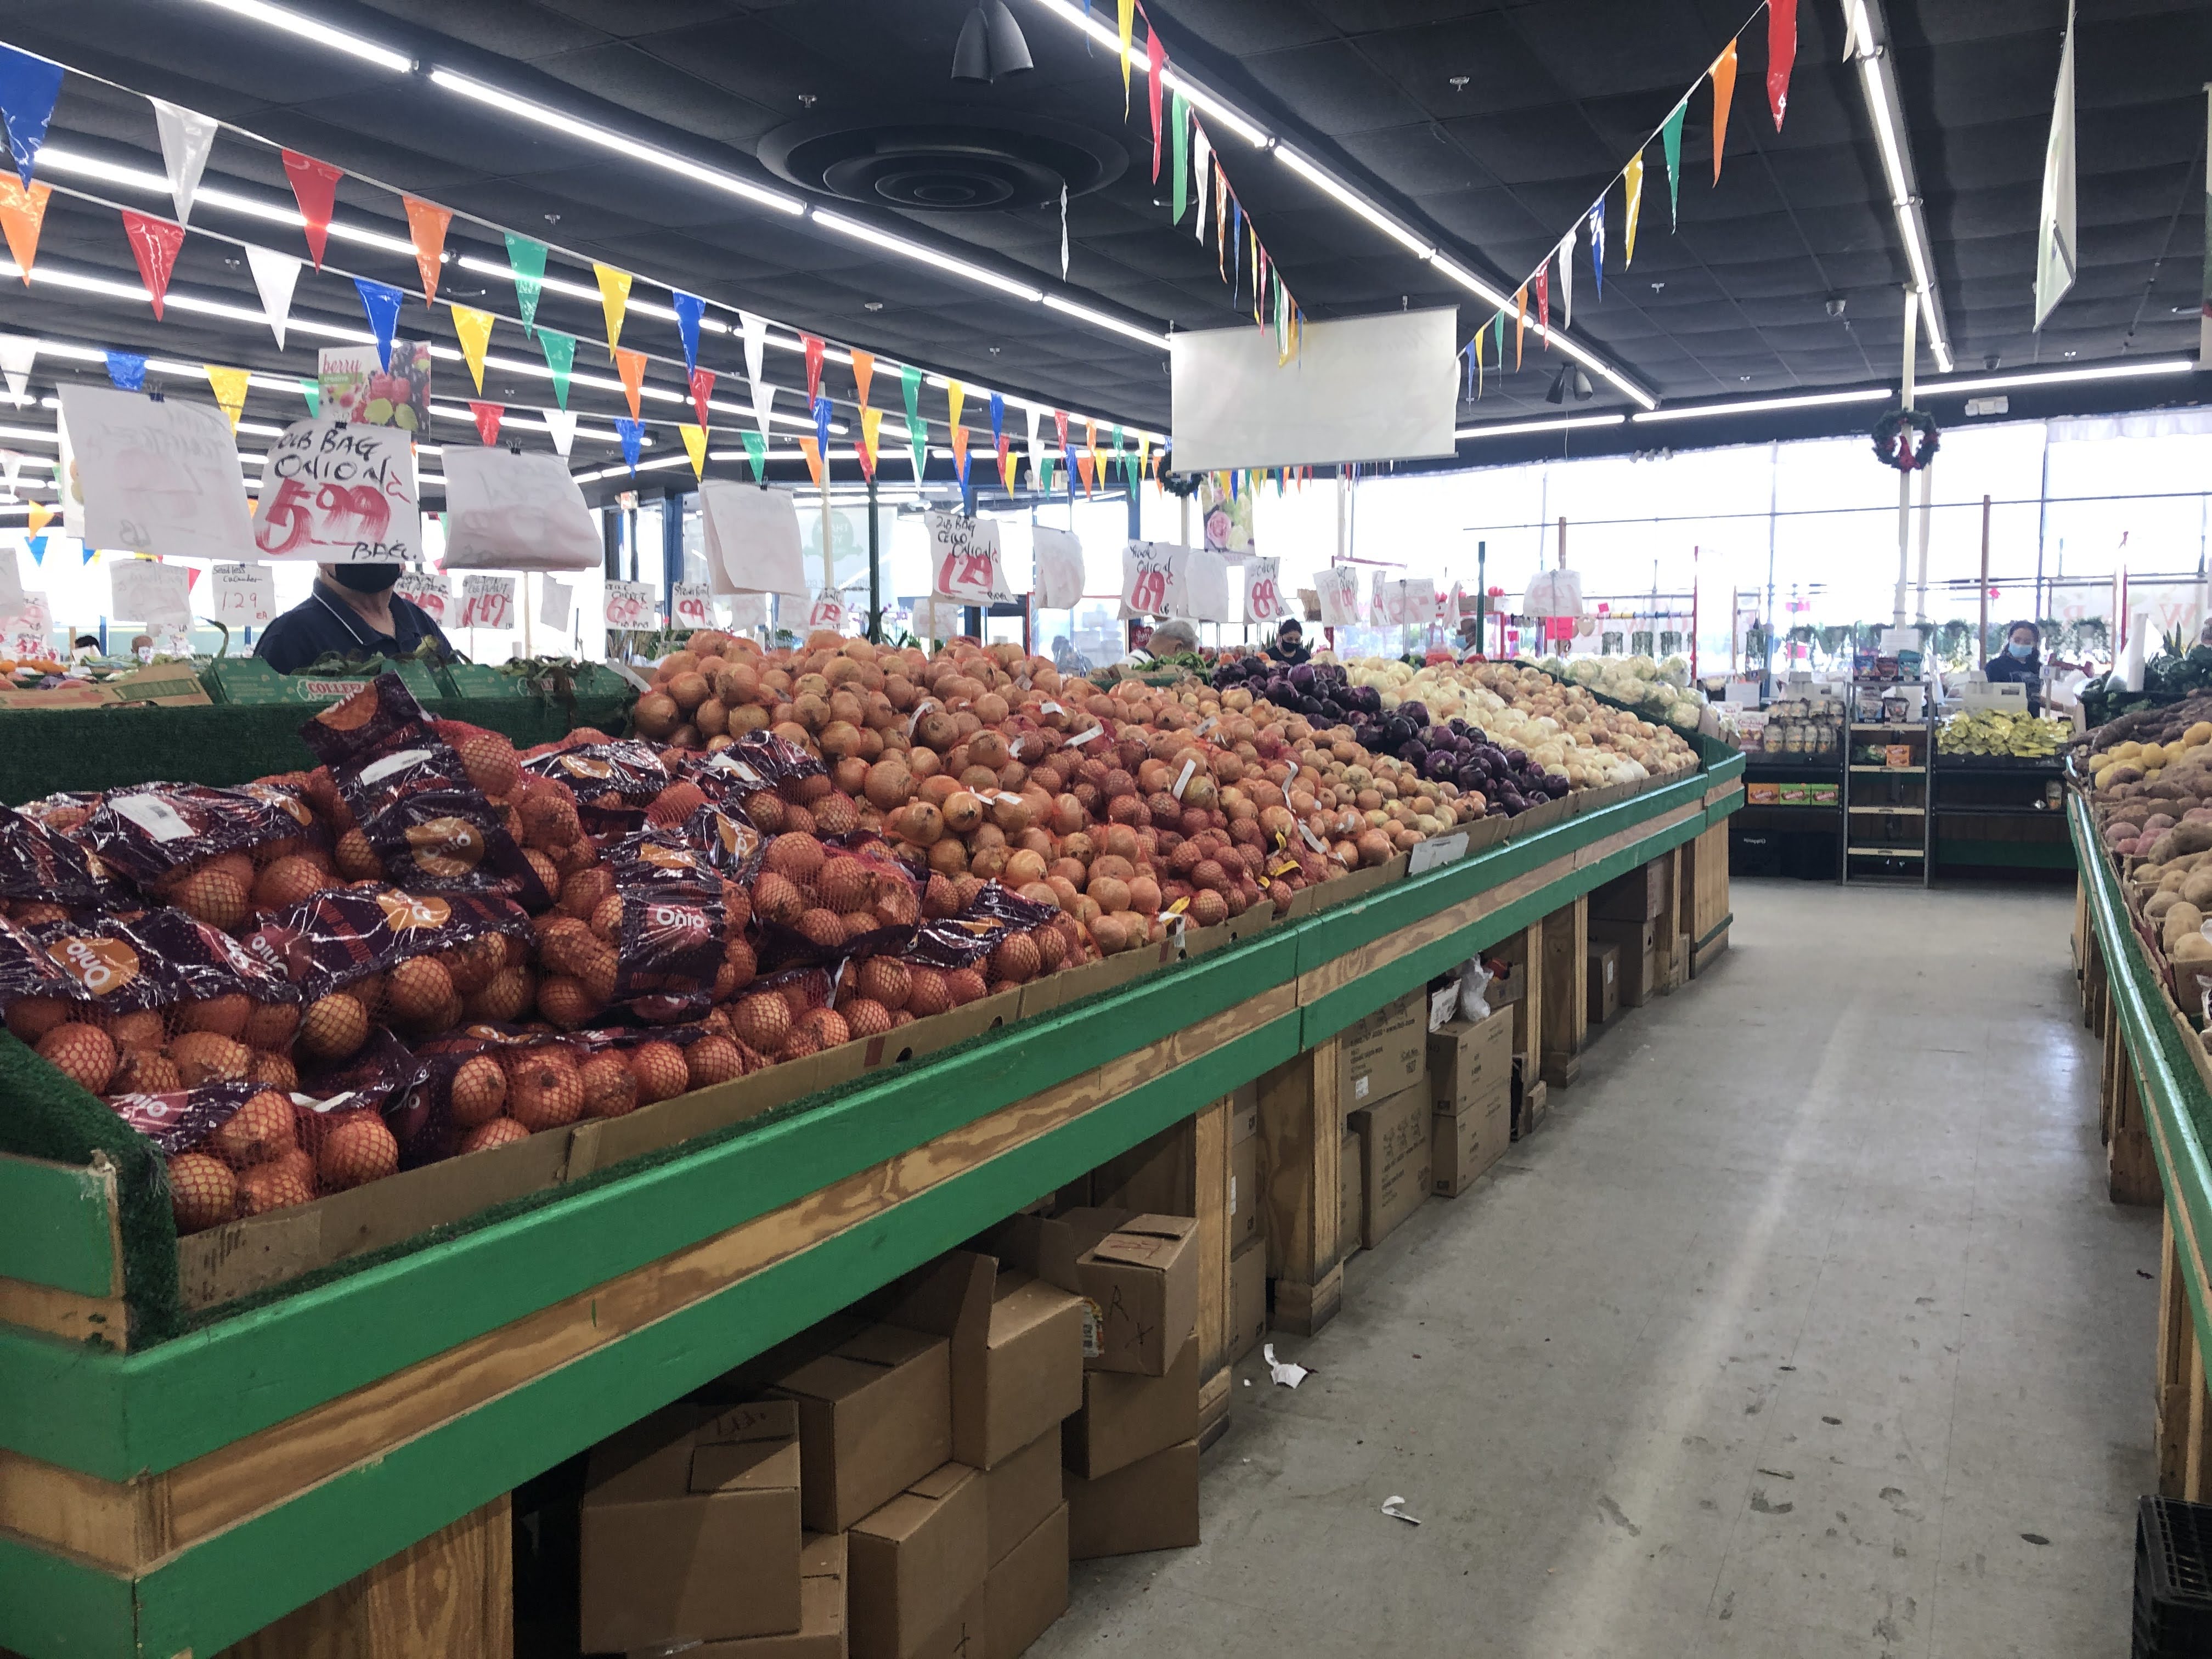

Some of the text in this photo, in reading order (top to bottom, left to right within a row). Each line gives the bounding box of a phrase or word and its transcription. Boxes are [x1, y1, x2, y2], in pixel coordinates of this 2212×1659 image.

[323, 354, 362, 385] berry
[320, 429, 383, 462] BAG
[213, 566, 245, 574] Seedless
[422, 830, 471, 859] Onio
[656, 907, 704, 928] Onio
[66, 943, 111, 987] Onio
